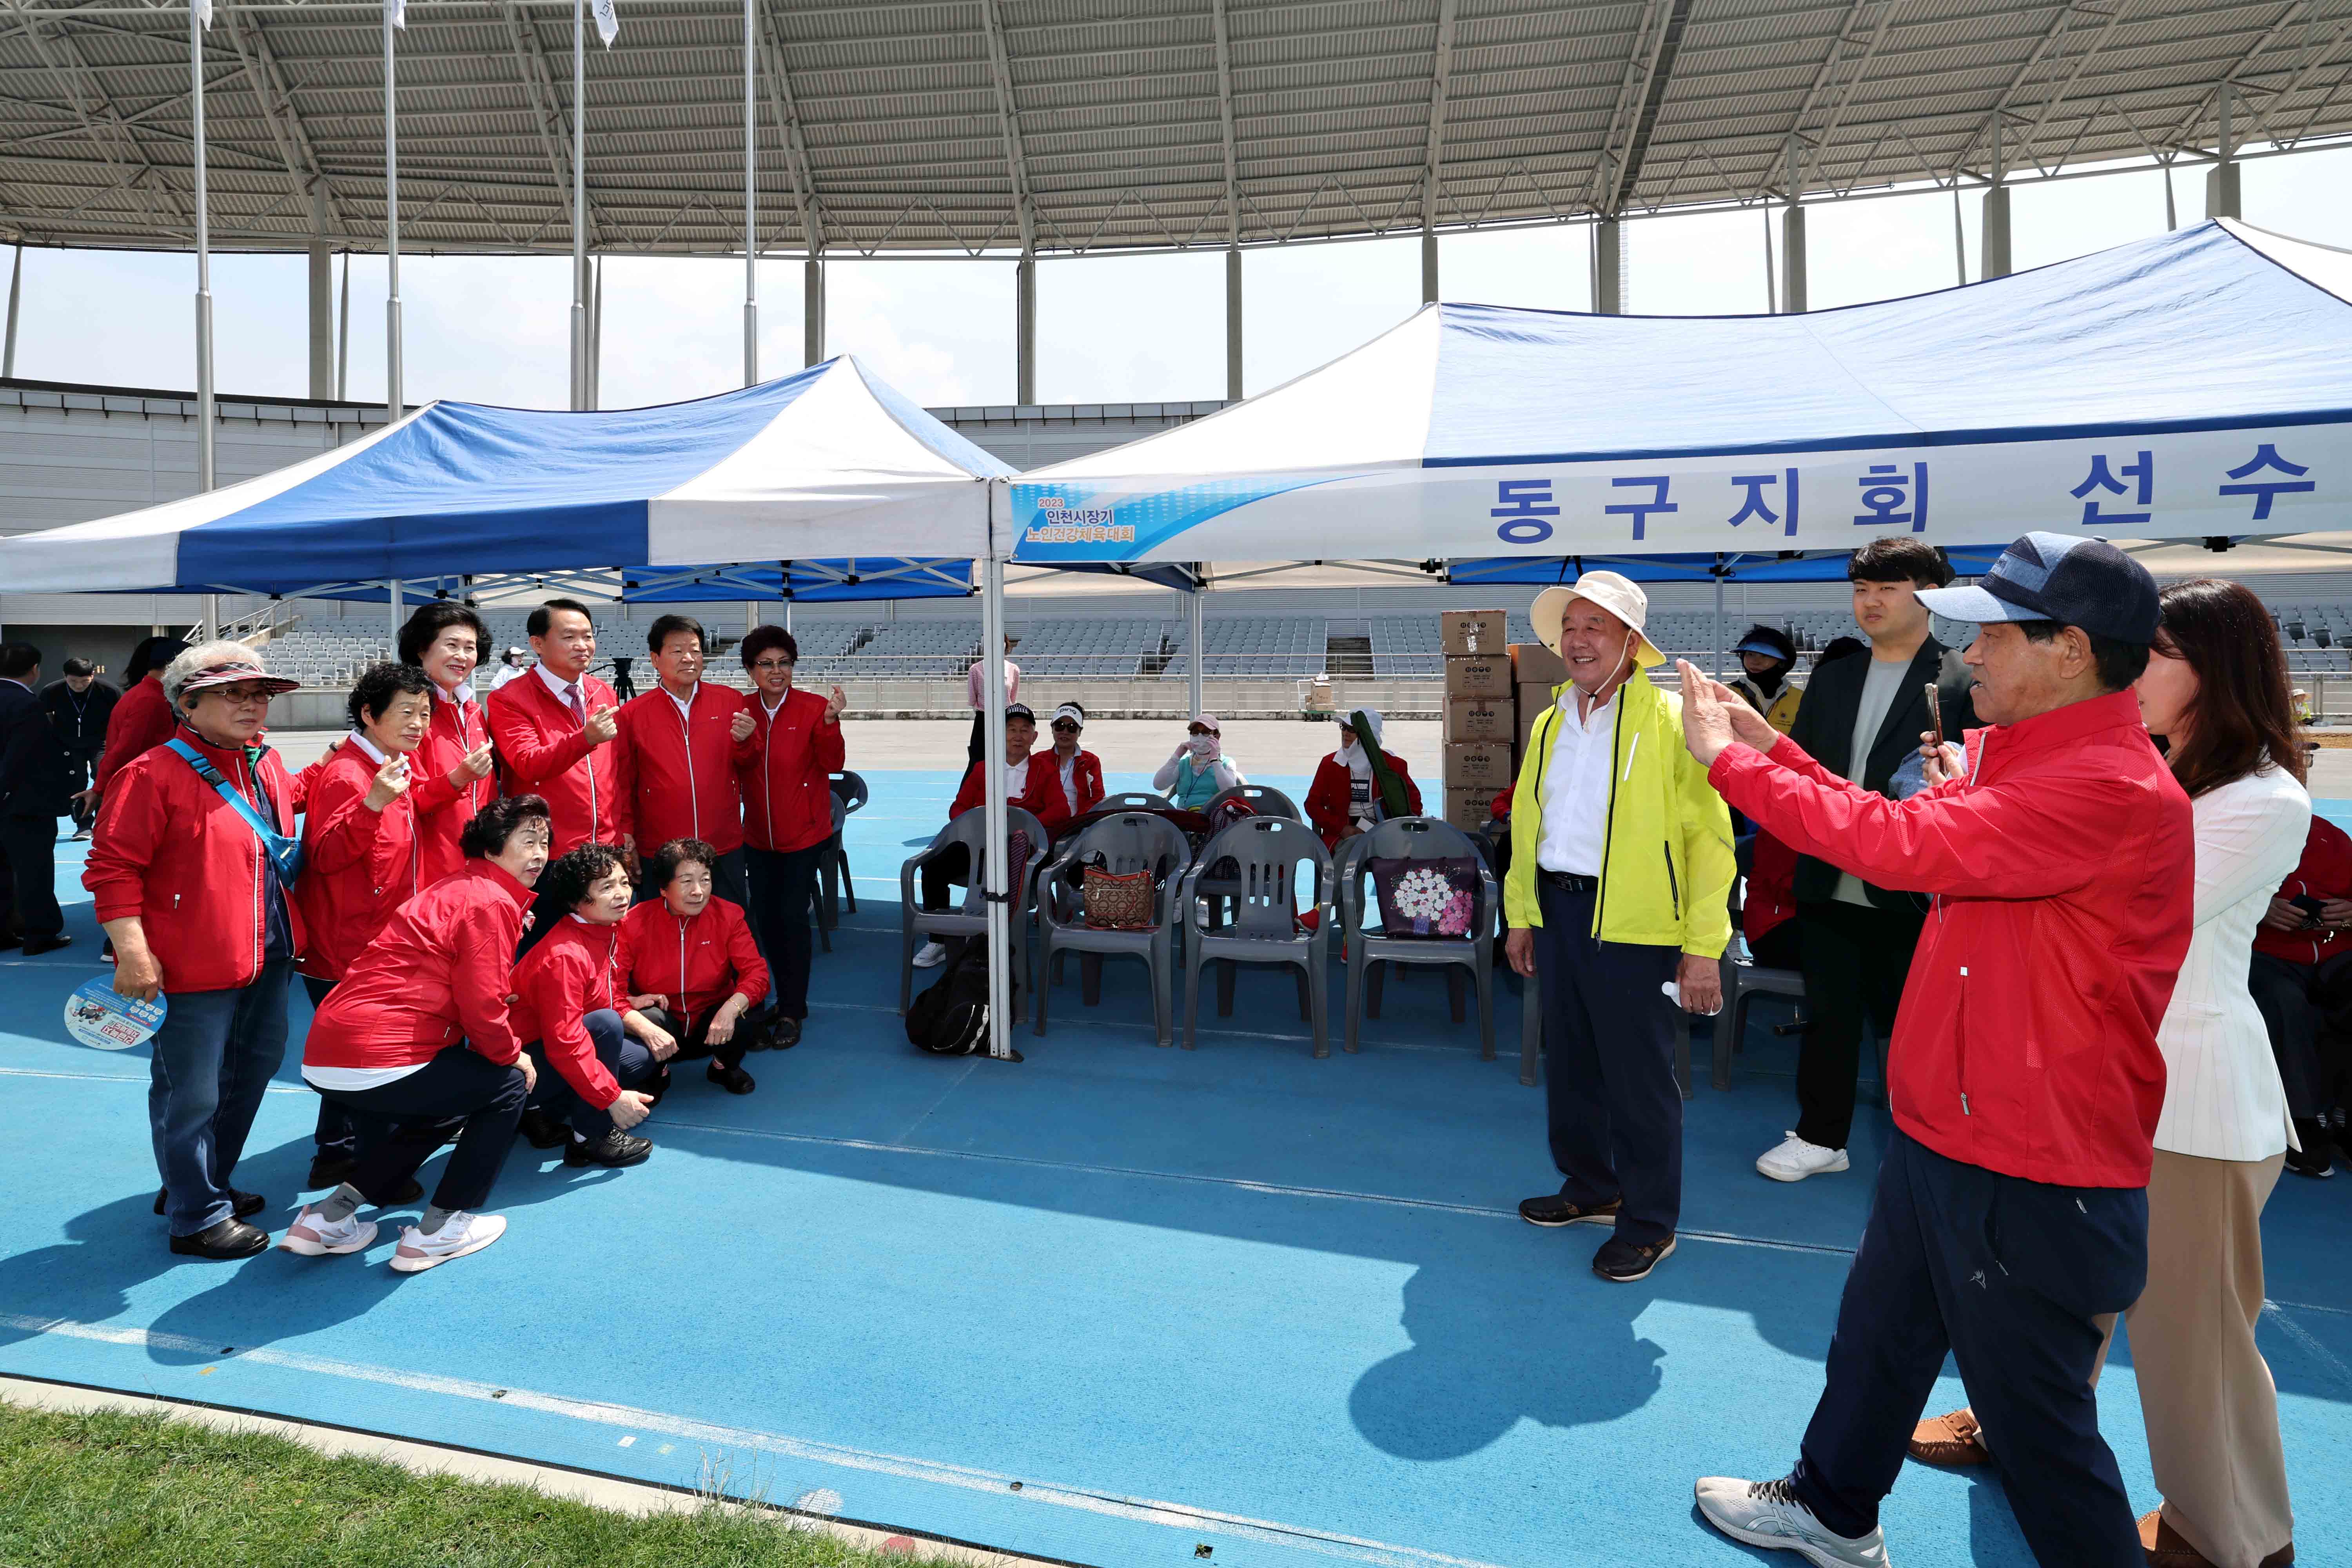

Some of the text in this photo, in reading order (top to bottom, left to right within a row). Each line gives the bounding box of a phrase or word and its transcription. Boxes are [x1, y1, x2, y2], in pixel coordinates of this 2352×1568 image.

[1491, 444, 2315, 544] 동구지회 선수
[1039, 499, 1063, 507] 2023
[1047, 510, 1112, 524] 인천시장기
[1027, 526, 1133, 541] 노인건강체육대회
